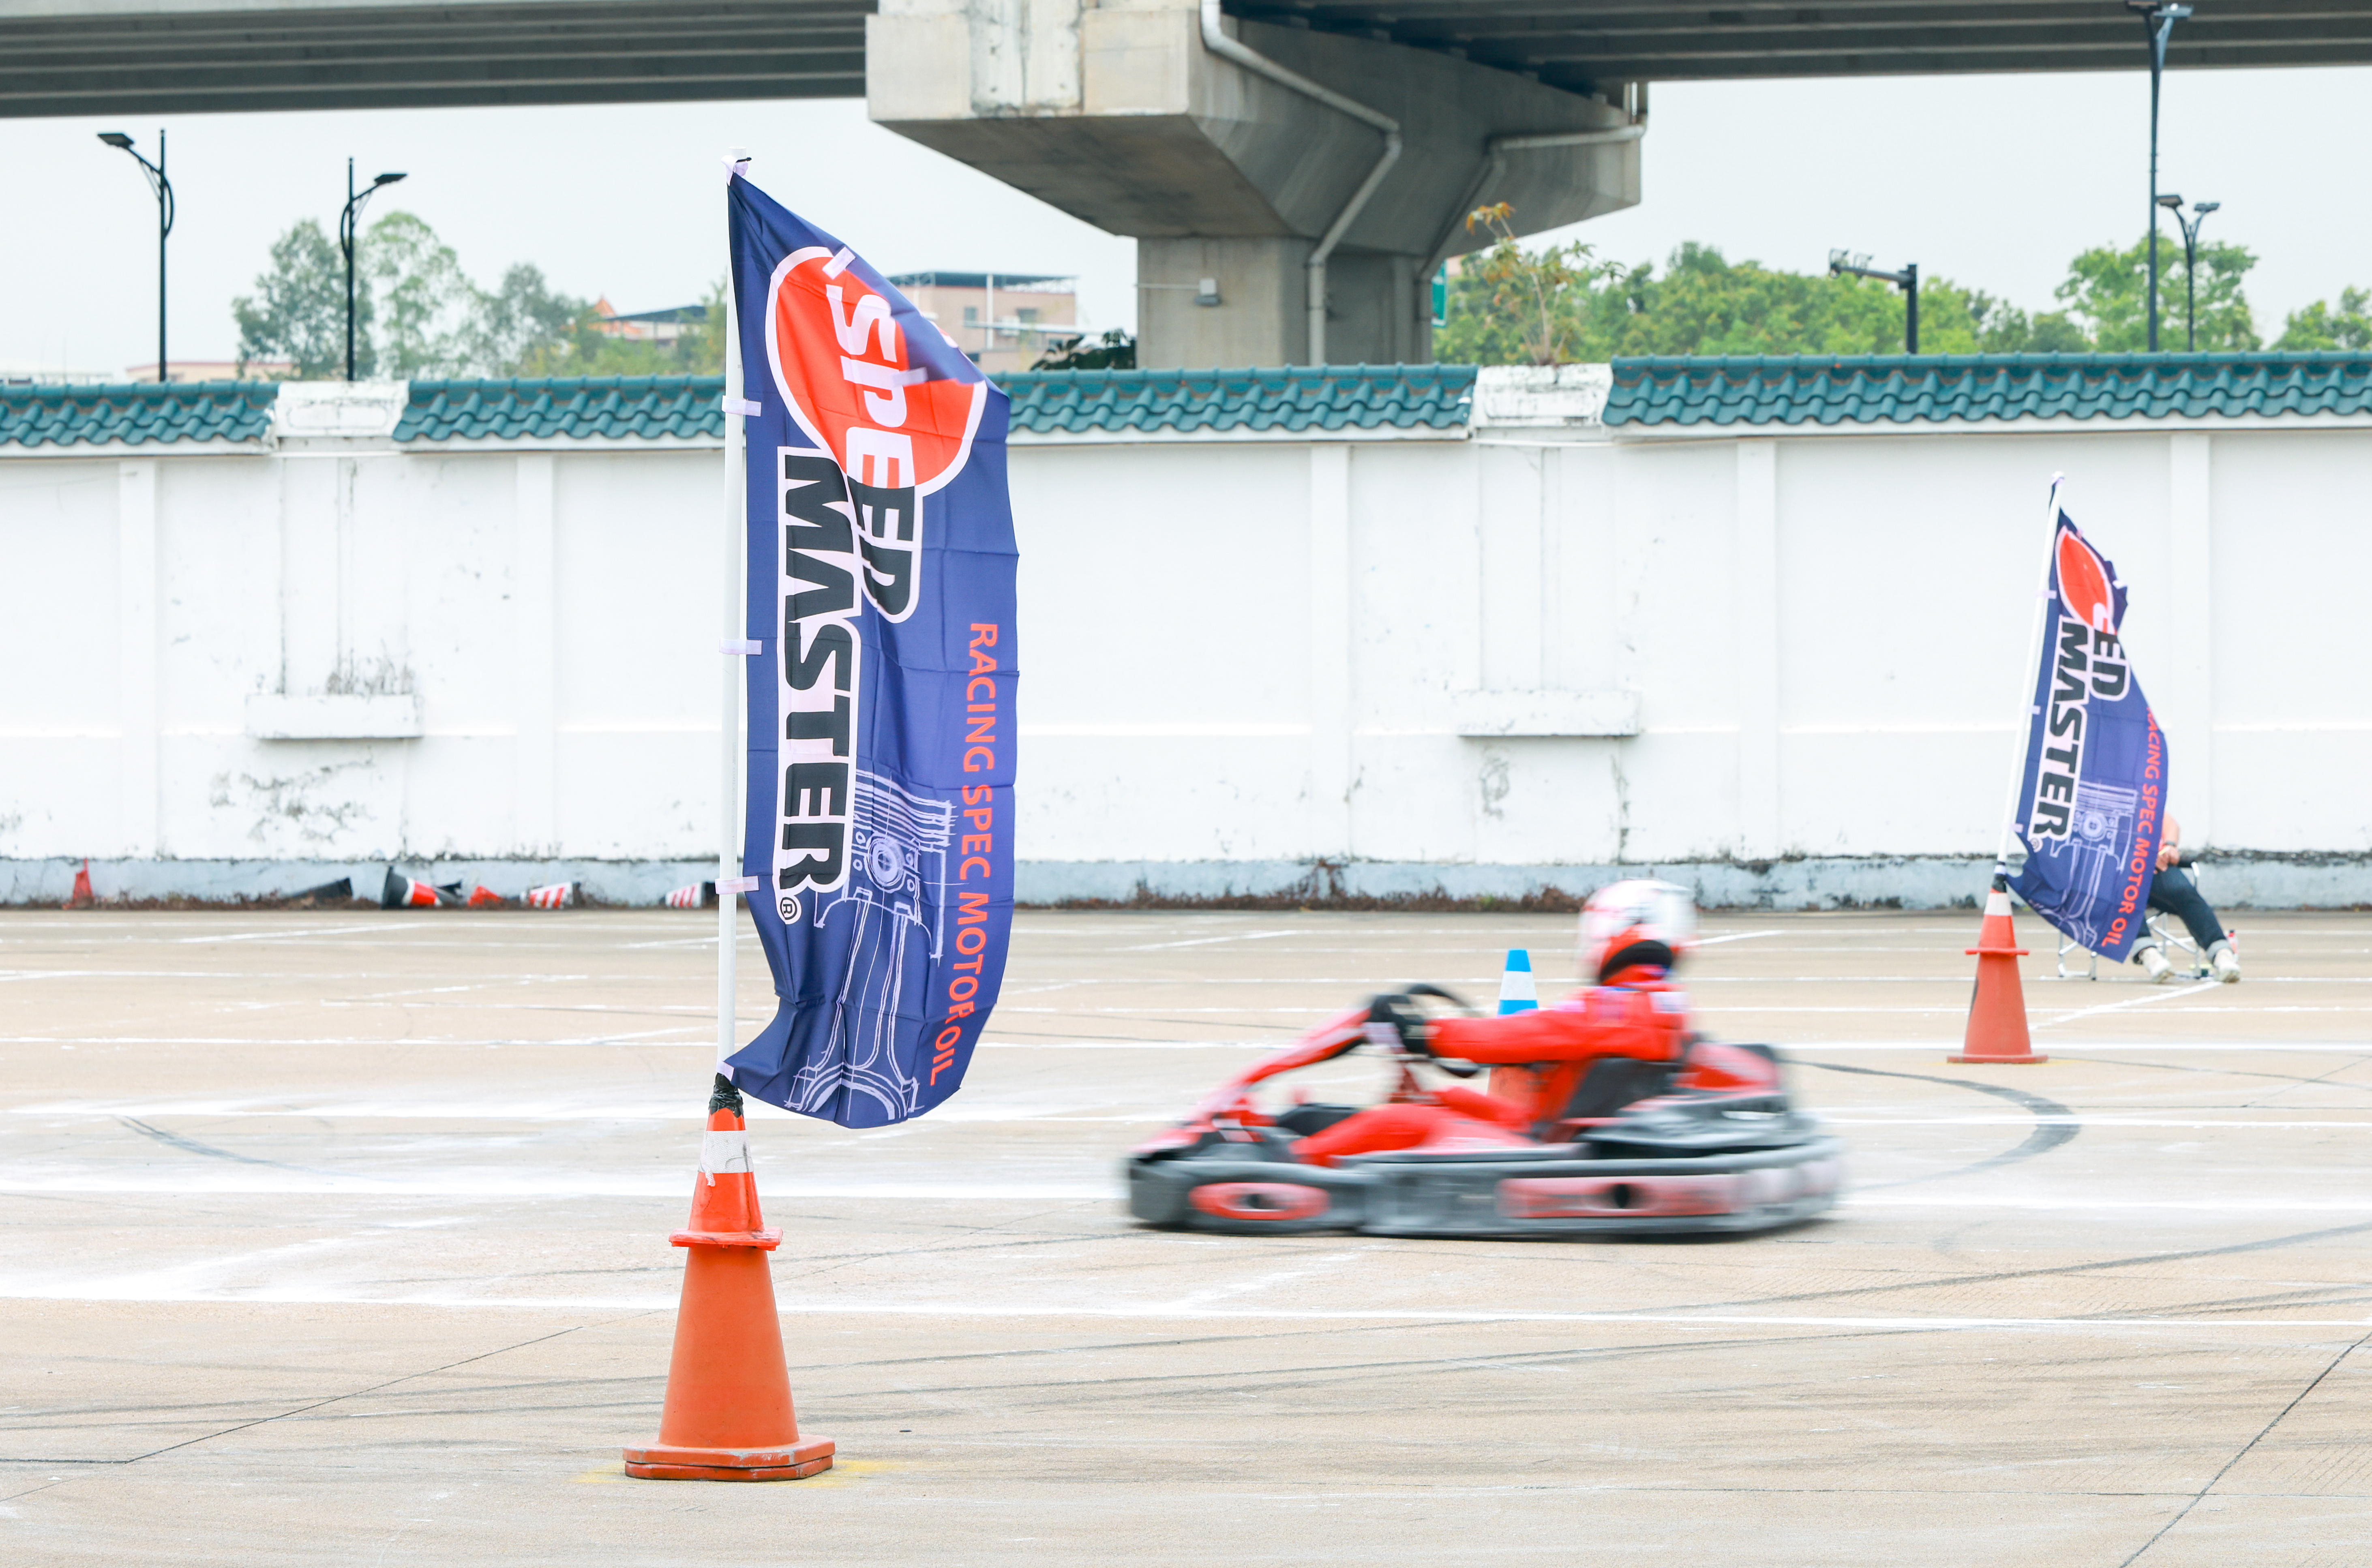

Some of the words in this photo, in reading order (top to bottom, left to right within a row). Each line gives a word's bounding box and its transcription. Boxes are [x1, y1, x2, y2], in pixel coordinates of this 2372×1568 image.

[825, 283, 916, 615] SPEED
[780, 454, 855, 893] MASTER
[963, 623, 998, 773] RACING
[2033, 621, 2088, 836] MASTER
[959, 784, 992, 880] SPEC
[2137, 782, 2158, 834] SPEC
[2101, 919, 2127, 947] OIL
[2118, 838, 2151, 914] MOTOR
[945, 892, 988, 1024] MOTOR
[930, 1026, 962, 1086] OIL
